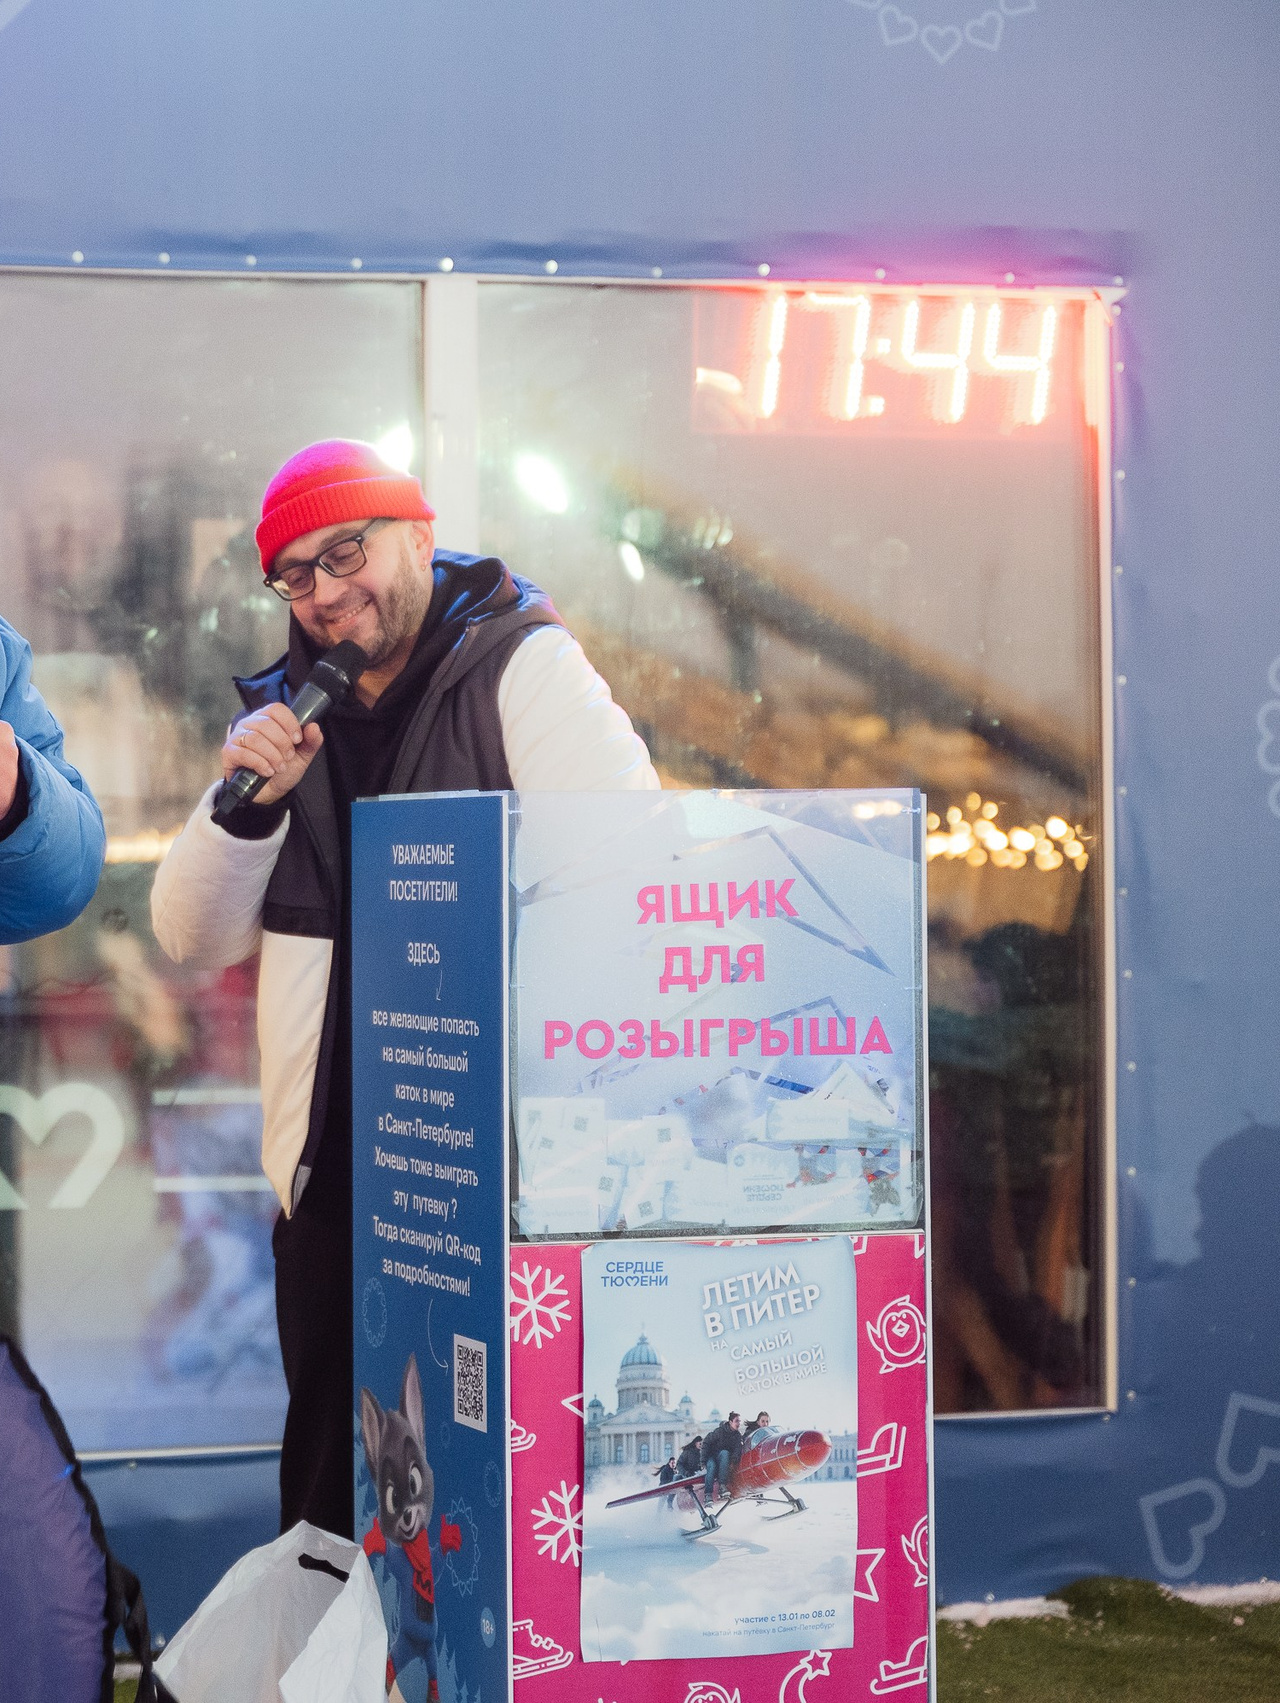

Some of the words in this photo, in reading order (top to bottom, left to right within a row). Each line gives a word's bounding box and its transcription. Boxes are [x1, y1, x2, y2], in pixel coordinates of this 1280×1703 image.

[762, 294, 1057, 424] 17:44
[392, 844, 454, 864] УВАЖАЕМЫЕ
[389, 880, 458, 901] ПОСЕТИТЕЛИ!
[636, 878, 799, 928] ЯЩИК
[407, 942, 441, 966] ЗДЕСЬ
[659, 944, 765, 994] ДЛЯ
[372, 1010, 388, 1026] все
[389, 1011, 439, 1034] желающие
[441, 1017, 480, 1036] попасть
[544, 1016, 893, 1060] РОЗЫГРЫША
[382, 1046, 393, 1062] на
[395, 1045, 425, 1066] самый
[426, 1047, 468, 1072] большой
[395, 1084, 421, 1102] каток
[422, 1088, 428, 1103] в
[430, 1089, 455, 1111] мире
[378, 1116, 384, 1131] в
[385, 1112, 474, 1150] Санкт-Петербурге!
[375, 1146, 409, 1172] Хочешь
[410, 1158, 433, 1177] тоже
[434, 1163, 479, 1188] выиграть
[393, 1190, 409, 1212] эту
[413, 1194, 449, 1222] путевку
[373, 1215, 398, 1243] Тогда
[400, 1227, 443, 1256] сканируй
[445, 1234, 481, 1266] QR-код
[382, 1258, 393, 1274] за
[394, 1261, 470, 1297] подробностями!
[605, 1261, 664, 1275] СЕРДЦЕ
[702, 1261, 801, 1310] ЛЕТИМ
[704, 1311, 725, 1338] В
[730, 1284, 820, 1331] ПИТЕР
[711, 1339, 729, 1352] НА
[730, 1329, 793, 1361] САМЫЙ
[734, 1344, 825, 1383] БОЛЬШОЙ
[738, 1378, 781, 1396] КАТОК
[783, 1373, 792, 1384] В
[795, 1362, 828, 1381] МИРЕ
[482, 1618, 494, 1635] 18+
[702, 1628, 731, 1637] накатай
[777, 1621, 835, 1633] Санкт-Петербург
[735, 1615, 769, 1625] участие
[778, 1612, 798, 1621] 13.01
[812, 1609, 836, 1619] 08.02
